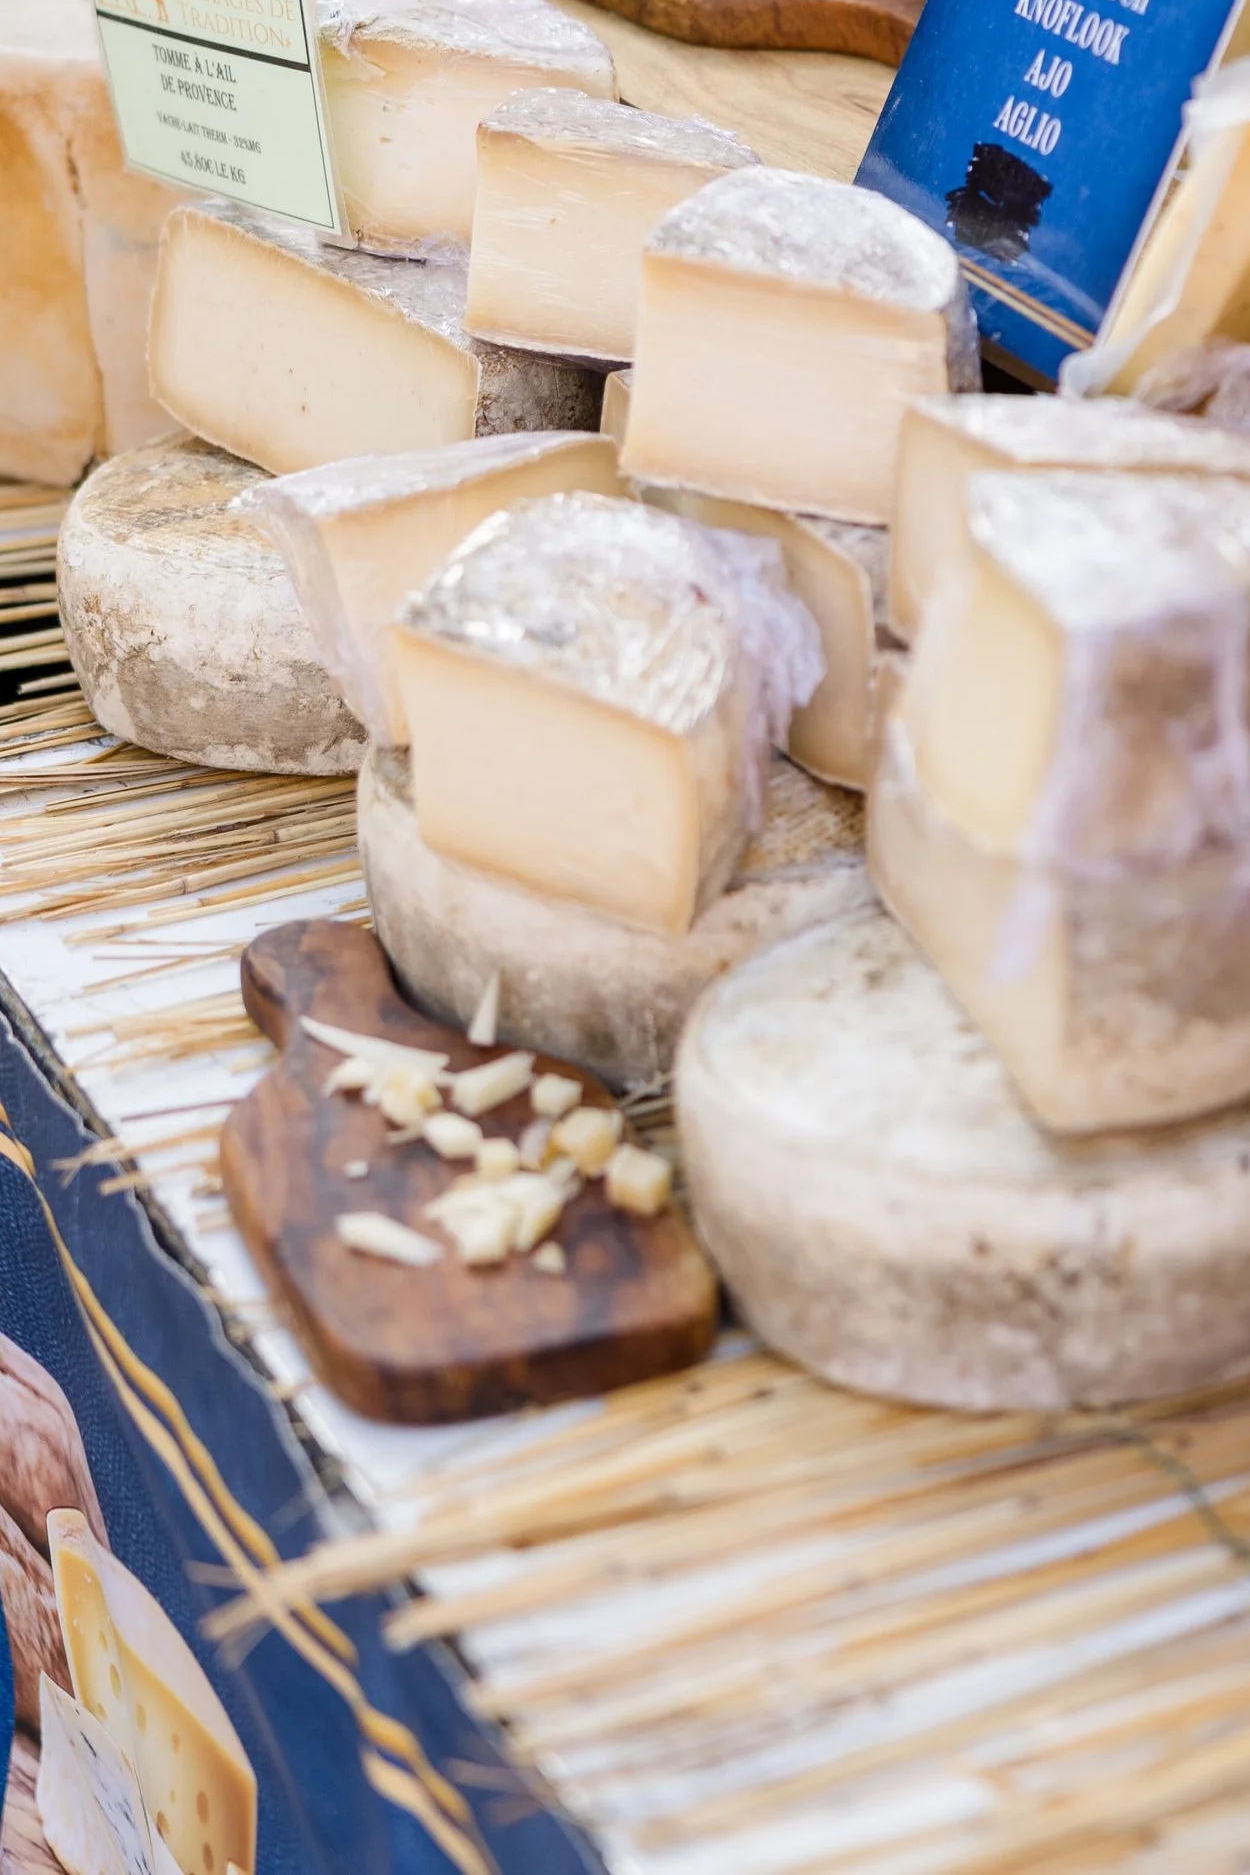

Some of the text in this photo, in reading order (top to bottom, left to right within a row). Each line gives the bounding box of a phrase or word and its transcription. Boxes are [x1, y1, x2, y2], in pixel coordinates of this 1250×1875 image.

[152, 43, 191, 71] TOMME
[205, 58, 237, 84] L'AIL
[1023, 47, 1074, 100] AJO
[160, 73, 237, 112] DE PROVENCE
[992, 94, 1062, 156] AGLIO
[230, 164, 246, 185] KG
